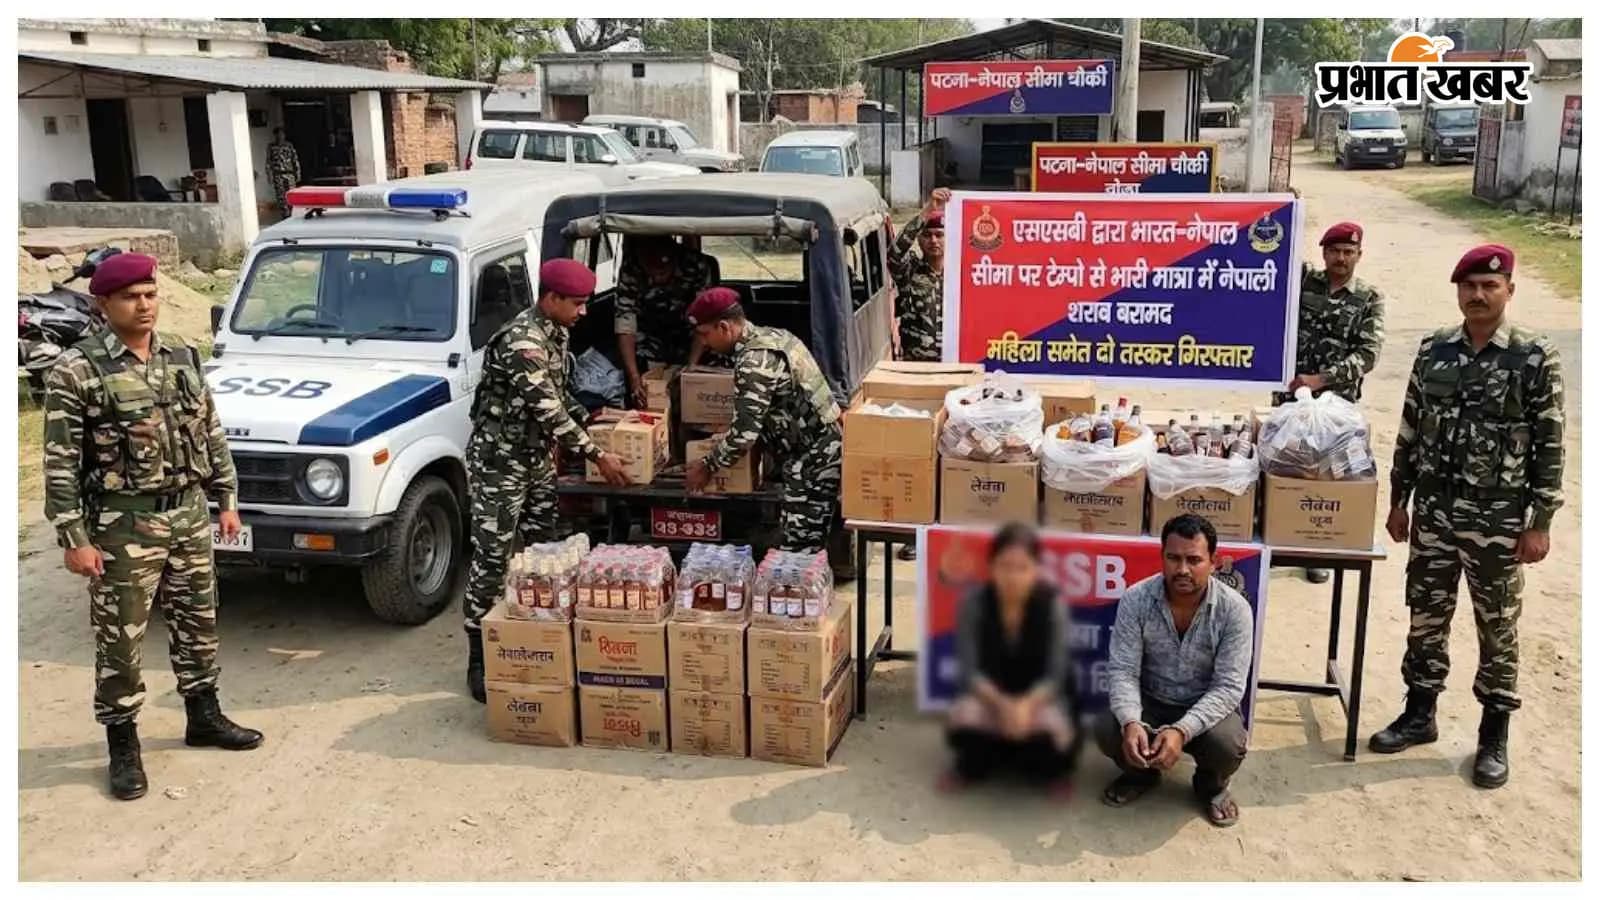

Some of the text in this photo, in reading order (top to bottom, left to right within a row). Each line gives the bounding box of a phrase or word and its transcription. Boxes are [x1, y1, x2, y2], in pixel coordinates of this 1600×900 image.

[930, 67, 1020, 89] पटना-नेपाल
[1025, 65, 1063, 89] सीमा
[1039, 152, 1128, 174] पटना-नेपाल
[1130, 151, 1167, 175] सीमा
[1012, 212, 1239, 245] एसएसबी द्वारा भारत-नेपाल
[971, 255, 1277, 291] सीमा पर टेम्पो से भारी मात्रा में नेपाली
[1116, 302, 1174, 325] बरामद
[986, 330, 1042, 363] महिला
[1047, 335, 1091, 364] समेत
[1096, 334, 1116, 366] दो
[1120, 342, 1175, 367] तस्कर
[211, 377, 332, 399] SSB
